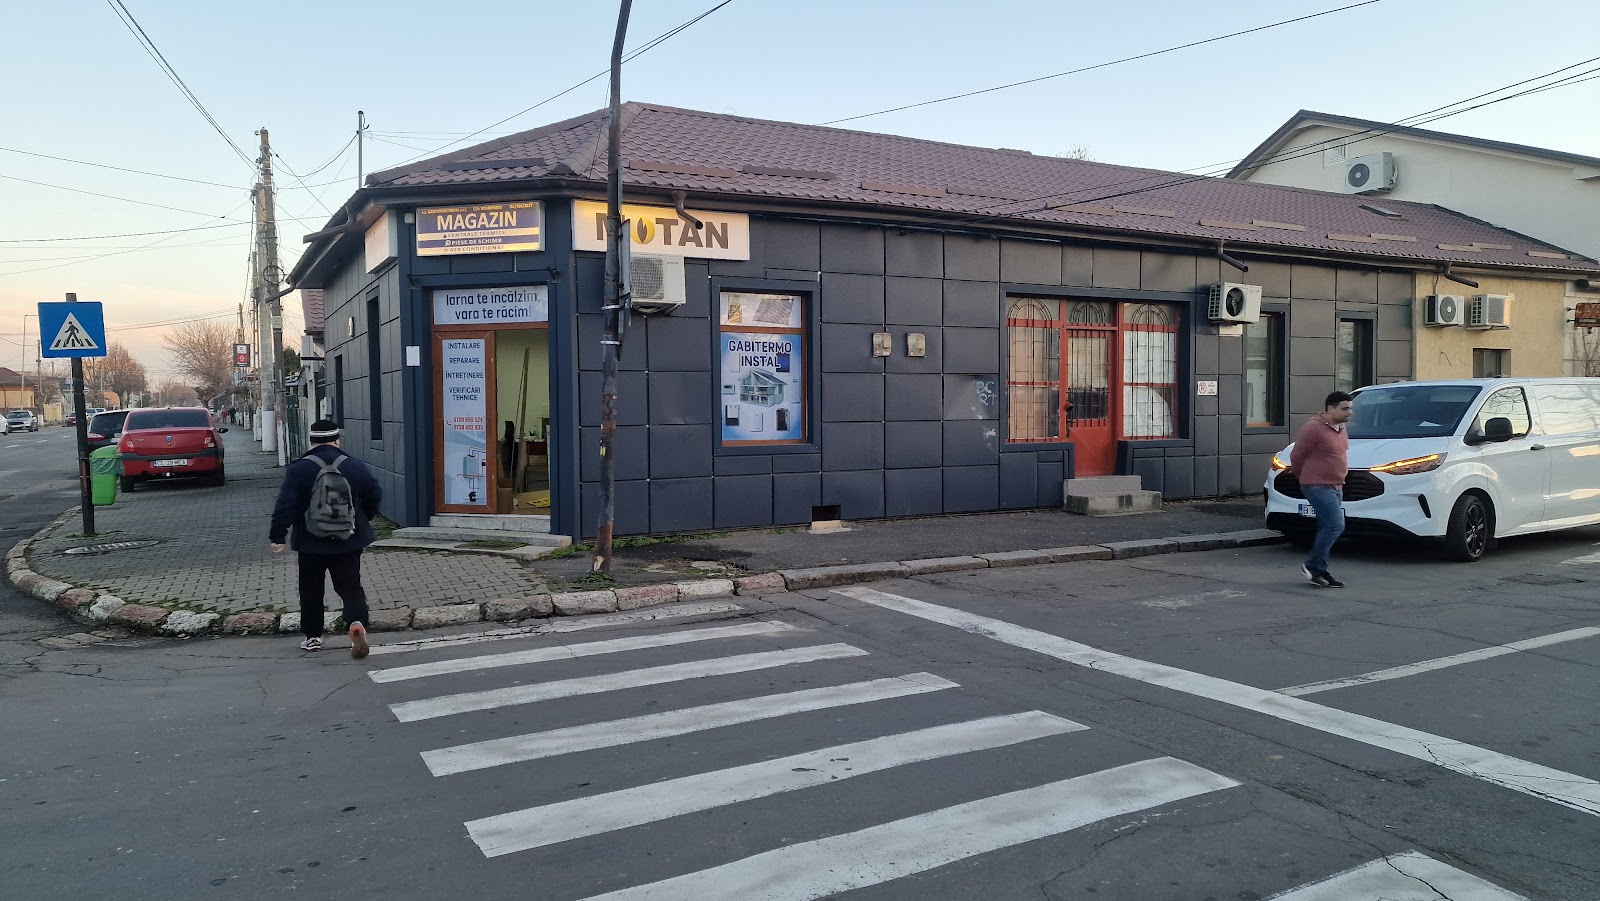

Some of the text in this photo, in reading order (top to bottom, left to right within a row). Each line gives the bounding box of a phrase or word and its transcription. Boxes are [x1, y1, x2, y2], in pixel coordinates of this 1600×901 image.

[437, 211, 517, 231] MAGAZIN
[446, 294, 474, 306] Iarna
[477, 293, 488, 304] te
[455, 305, 532, 320] vara te răcim!
[728, 340, 792, 353] GABITERMO
[741, 355, 780, 368] INSTAL
[445, 371, 484, 380] ÎNTREȚINERE
